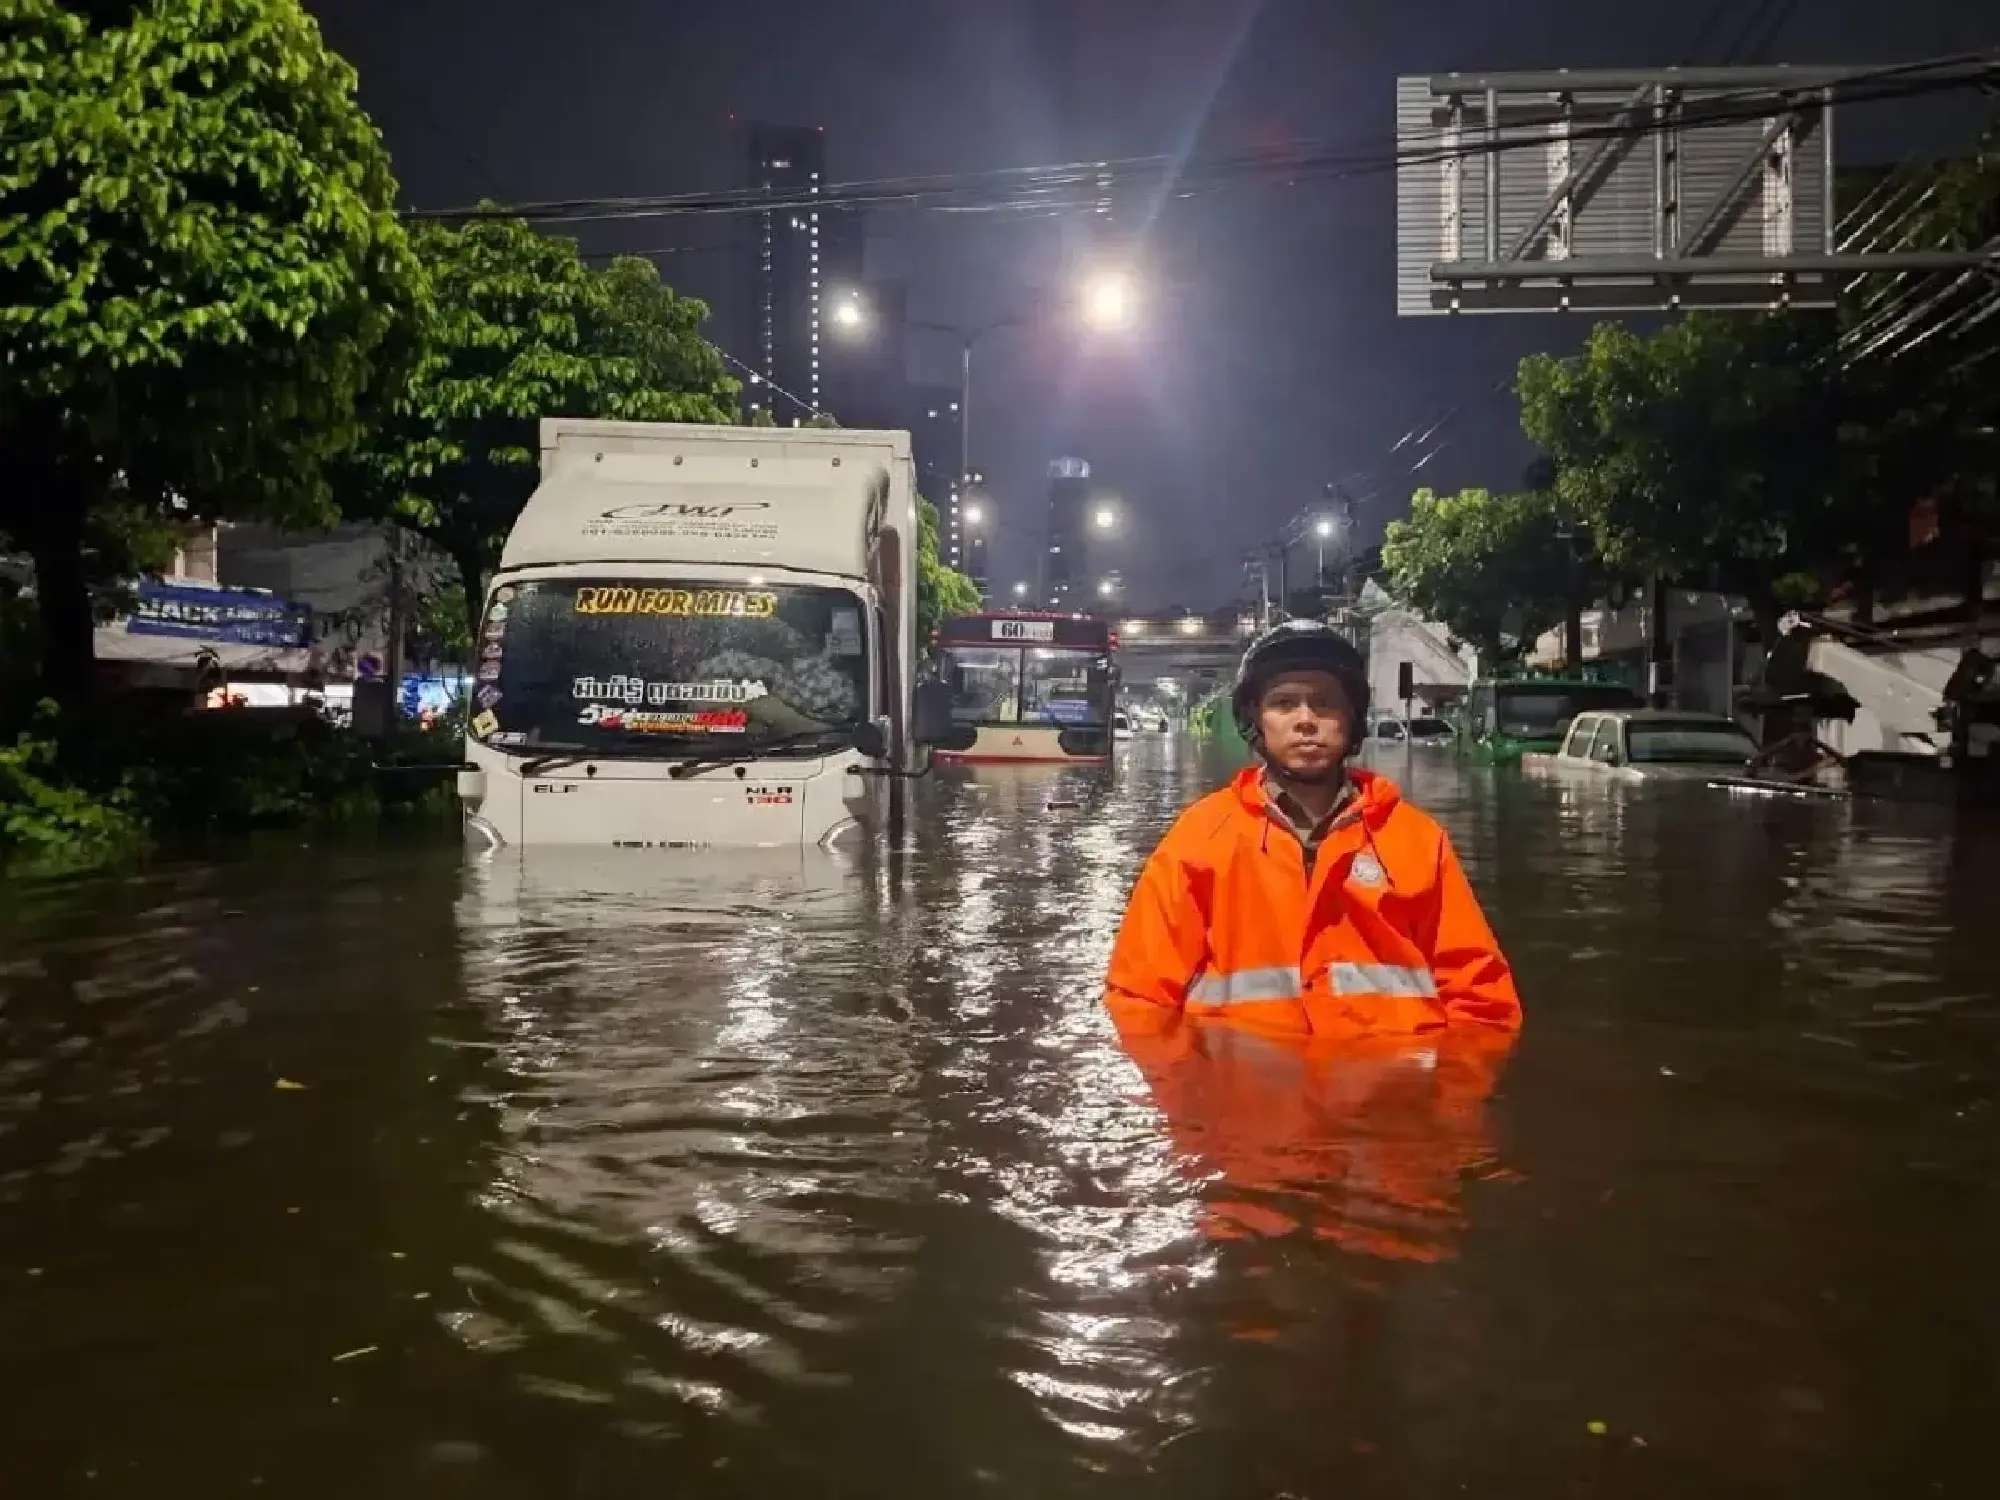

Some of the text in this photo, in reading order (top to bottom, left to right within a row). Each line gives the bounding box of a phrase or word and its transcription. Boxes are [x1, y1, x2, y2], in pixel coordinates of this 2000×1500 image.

[576, 587, 778, 617] RUN FOR MILES
[1001, 622, 1024, 638] 60
[533, 784, 578, 794] ELF
[745, 786, 792, 794] NLR
[746, 796, 792, 804] 130
